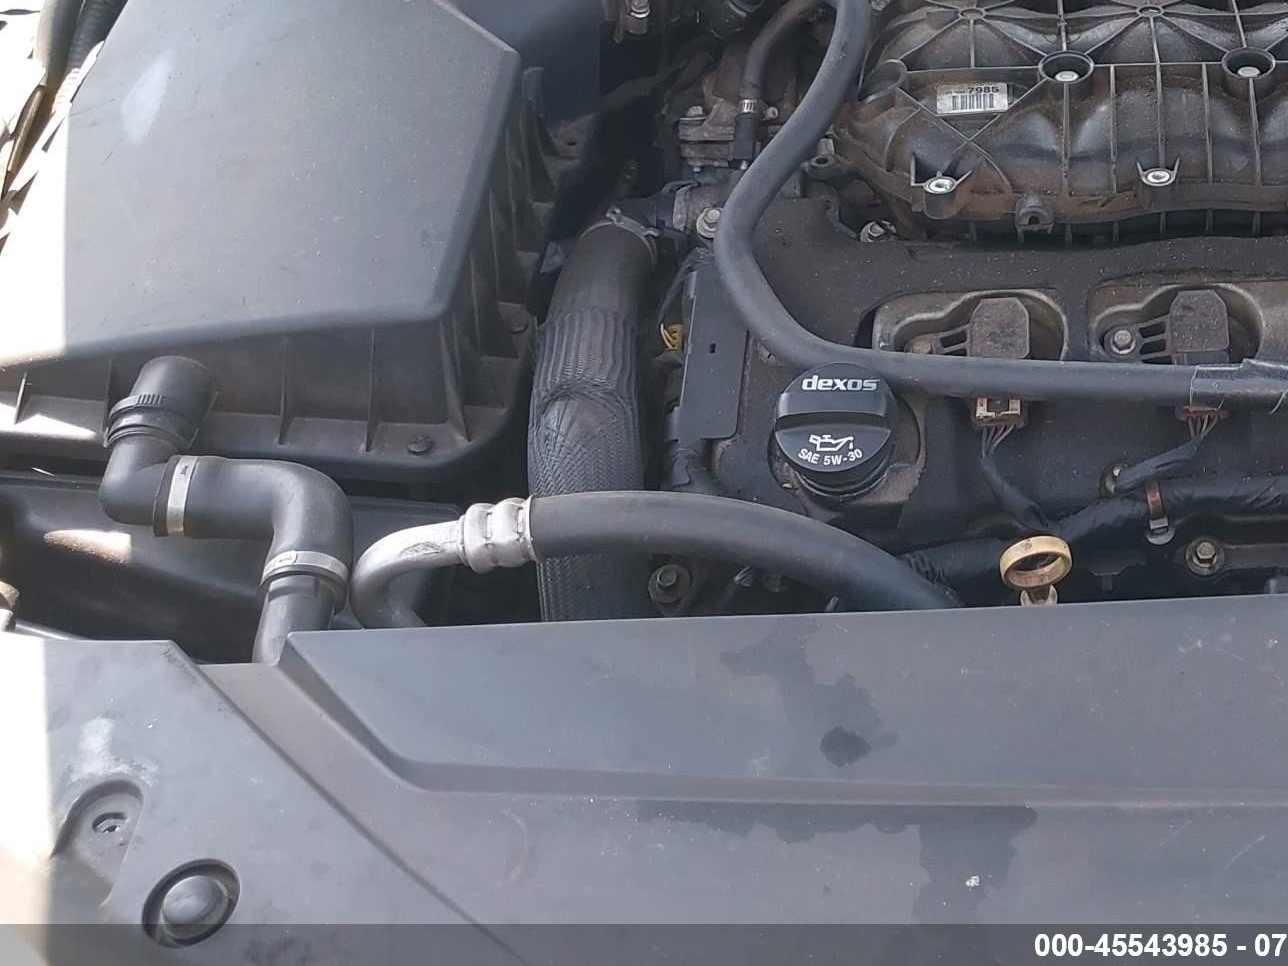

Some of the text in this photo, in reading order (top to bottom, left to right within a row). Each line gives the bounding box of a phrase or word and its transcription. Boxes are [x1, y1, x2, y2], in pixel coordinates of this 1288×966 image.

[967, 86, 1000, 94] 7985
[801, 375, 881, 392] dexos
[798, 448, 863, 465] SAE 5W-30
